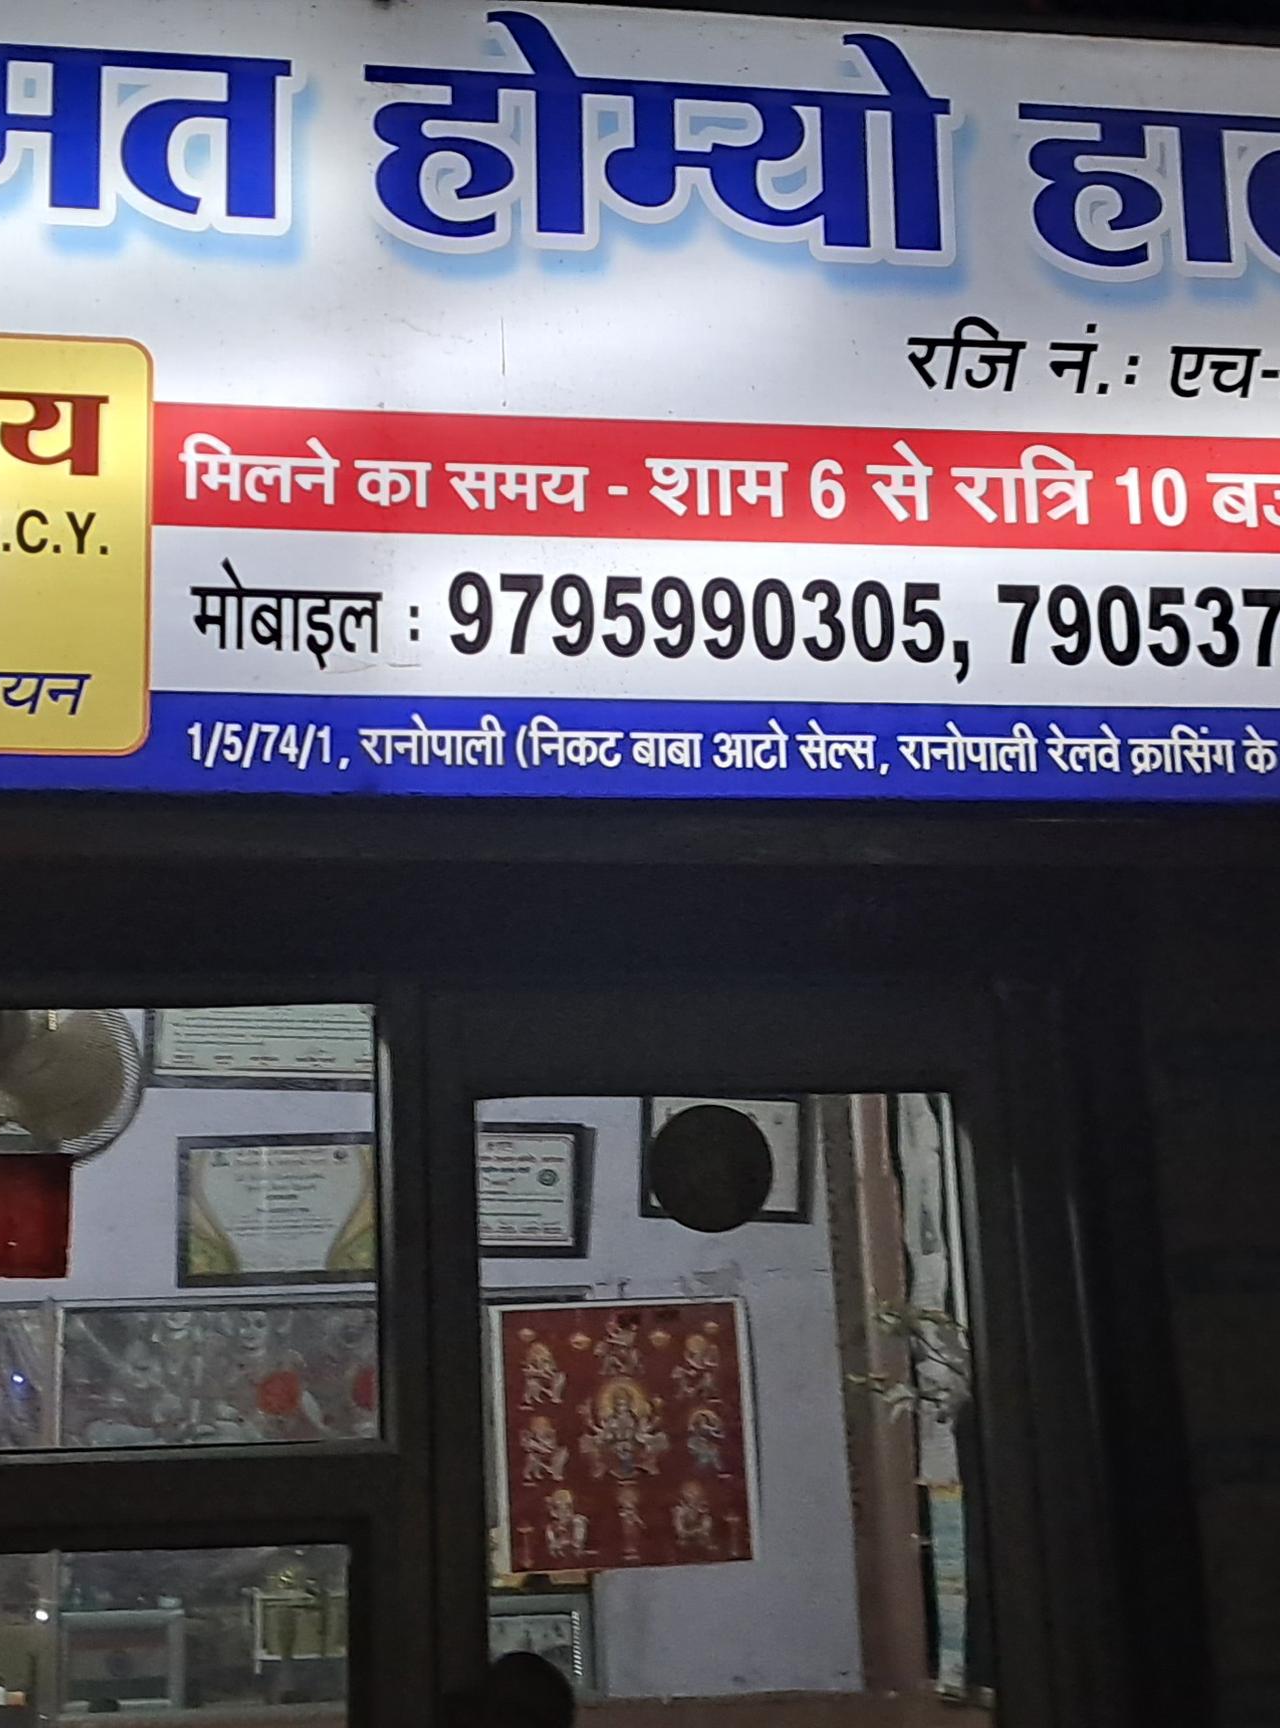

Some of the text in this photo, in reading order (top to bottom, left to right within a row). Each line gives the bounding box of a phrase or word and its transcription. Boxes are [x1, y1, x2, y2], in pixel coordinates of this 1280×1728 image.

[363, 11, 949, 253] होम्यो
[906, 316, 1023, 394] रजि
[179, 432, 340, 506] मिलने
[356, 461, 430, 508] का
[448, 461, 589, 513] समय
[646, 456, 789, 520] शाम
[810, 459, 847, 520] 6
[867, 440, 930, 522] से
[952, 445, 1093, 525] रात्रि
[1116, 467, 1188, 527] 10
[190, 557, 383, 670] मोबाइल
[448, 571, 971, 683] 9795990305,
[186, 722, 350, 774] 1/5/74/1,
[359, 715, 506, 770] रानोपाली
[515, 717, 624, 773] (निकट
[630, 731, 703, 770] बाबा
[710, 718, 789, 772] आटो
[795, 720, 889, 778] सेल्स,
[898, 723, 1040, 775] रानोपाली
[1045, 724, 1123, 776] रेलवे
[1130, 722, 1235, 778] क्रासिंग
[1245, 725, 1278, 776] के
